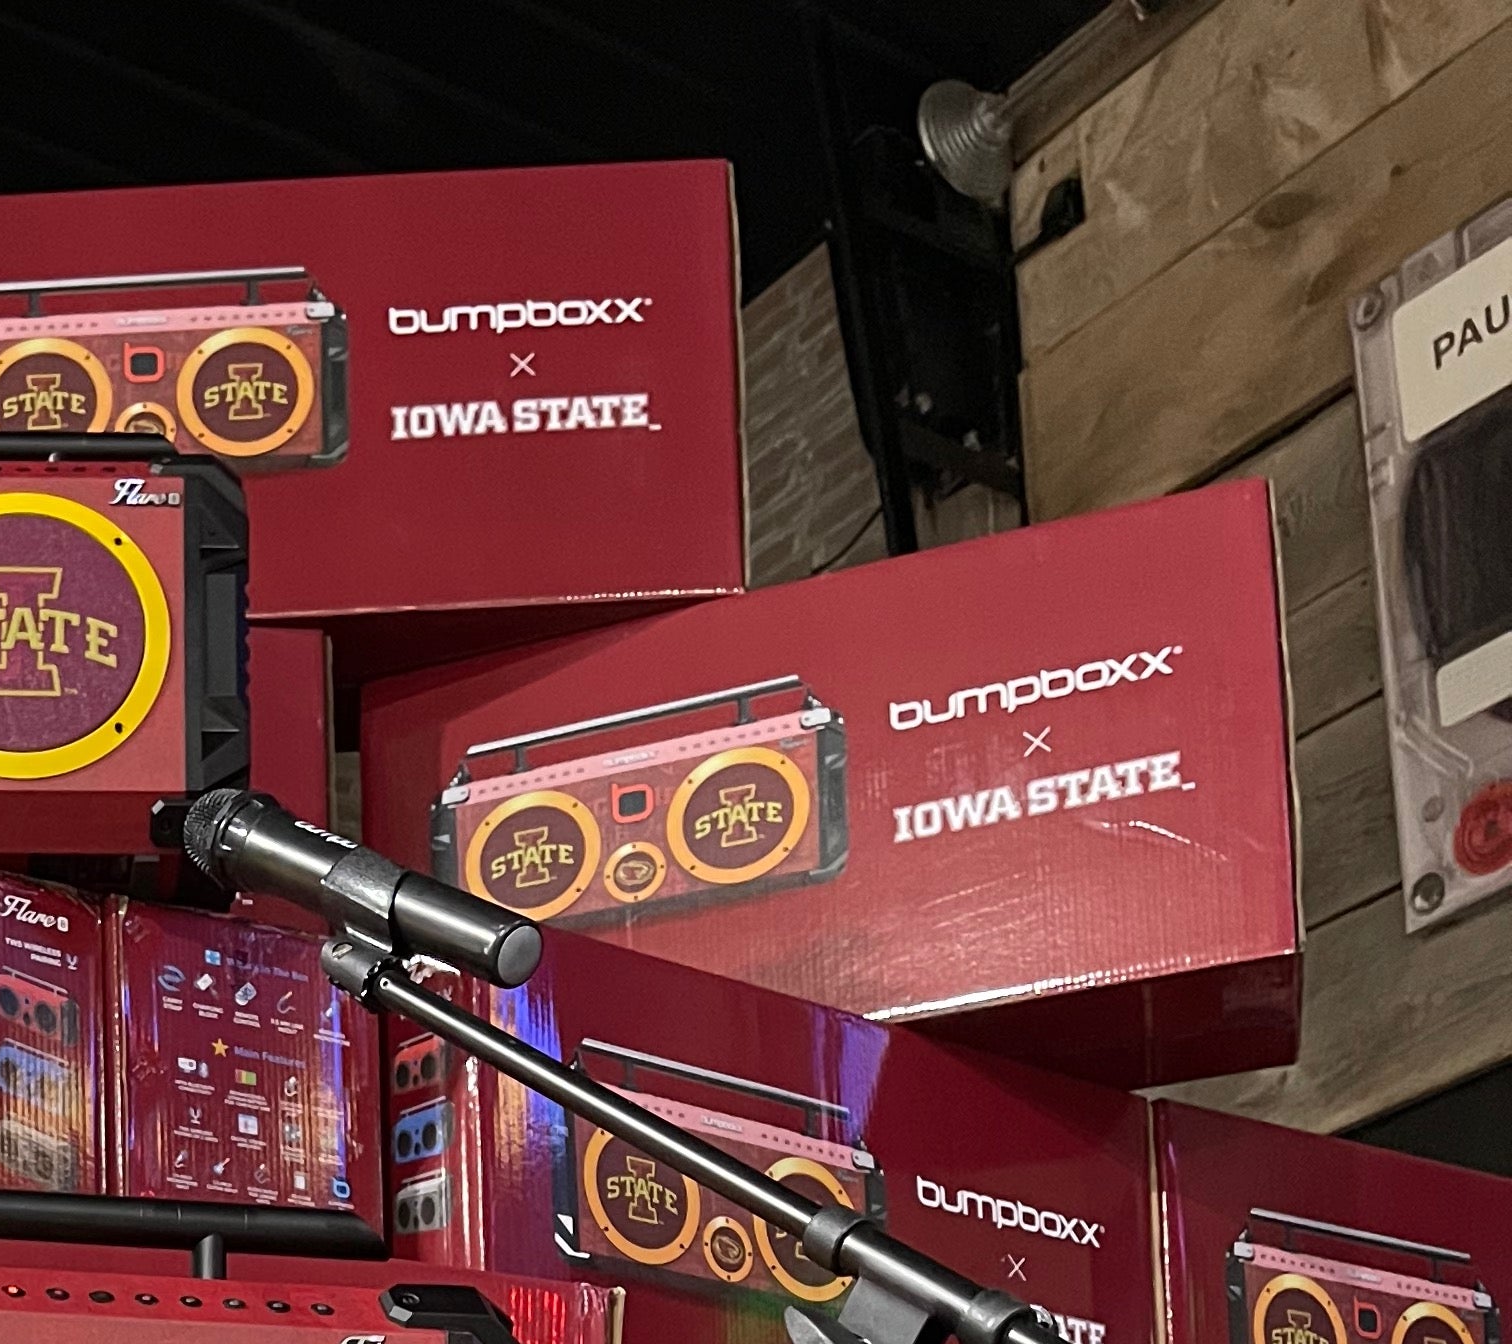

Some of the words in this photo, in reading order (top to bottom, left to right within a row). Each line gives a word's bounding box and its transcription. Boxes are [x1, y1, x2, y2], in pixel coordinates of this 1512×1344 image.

[388, 298, 648, 334] bumpboxx
[3, 391, 86, 419] STATE
[204, 382, 288, 409] STATE
[390, 400, 508, 441] IOWA
[512, 393, 649, 432] STATE
[890, 646, 1178, 730] bumpboxx
[893, 786, 1022, 843] IOWA
[1026, 750, 1182, 816] STATE
[695, 802, 784, 839] STATE
[491, 845, 574, 880] STATE
[607, 1176, 678, 1215] STATE
[916, 1175, 1101, 1248] bumpboxx
